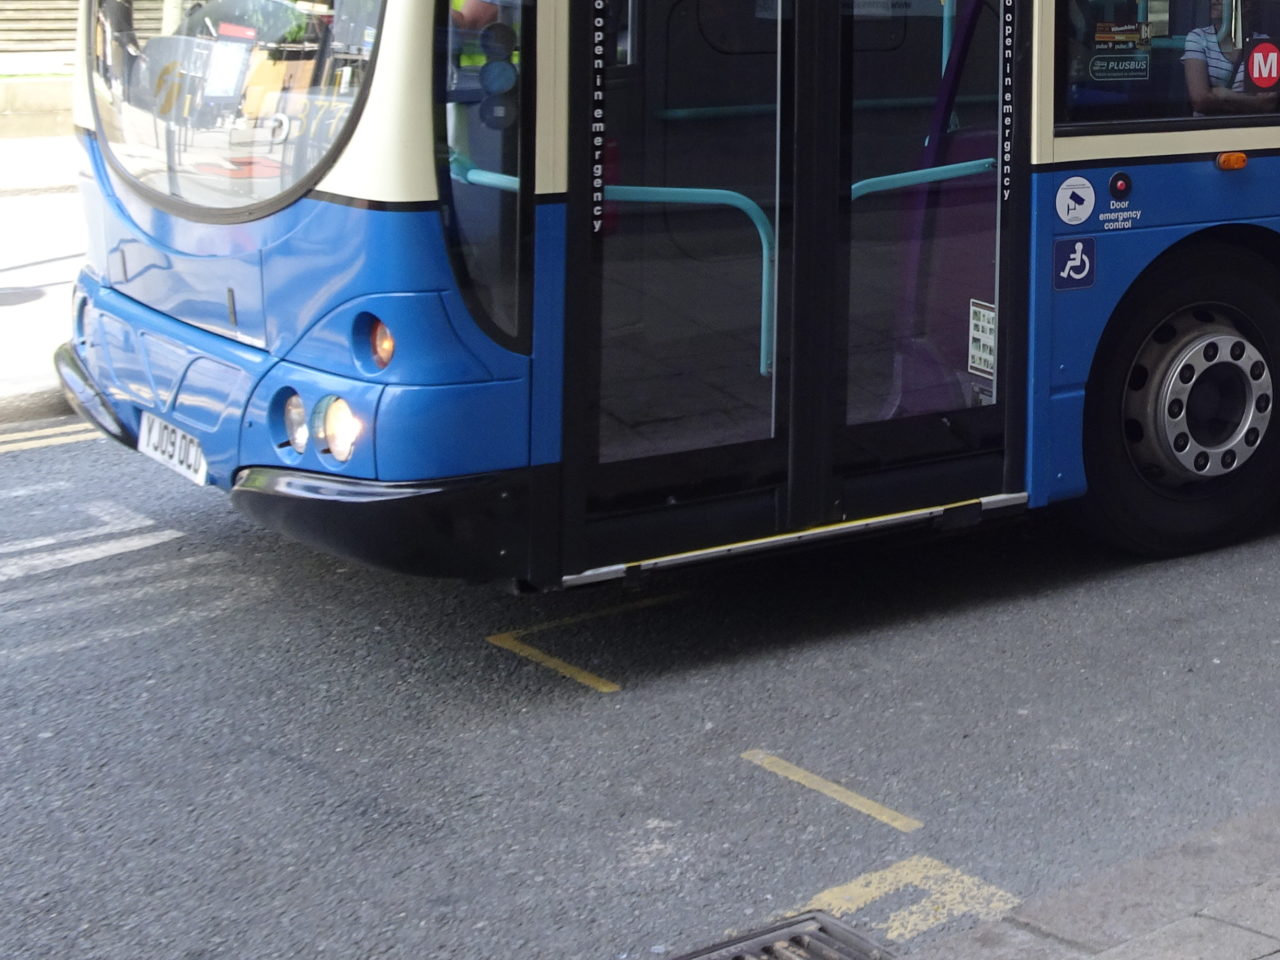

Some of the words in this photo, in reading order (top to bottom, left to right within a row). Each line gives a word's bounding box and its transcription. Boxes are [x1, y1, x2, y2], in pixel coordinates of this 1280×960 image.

[594, 18, 604, 68] open
[1005, 13, 1013, 59] open
[1004, 63, 1012, 86] in
[1108, 61, 1147, 70] PLUSBUS
[1253, 52, 1278, 78] M
[594, 75, 603, 100] in
[1003, 93, 1012, 201] emergency
[592, 108, 605, 232] emergency
[1099, 210, 1141, 222] emergency
[1110, 201, 1129, 209] Door
[1104, 220, 1132, 230] control
[146, 415, 177, 460] YJ09
